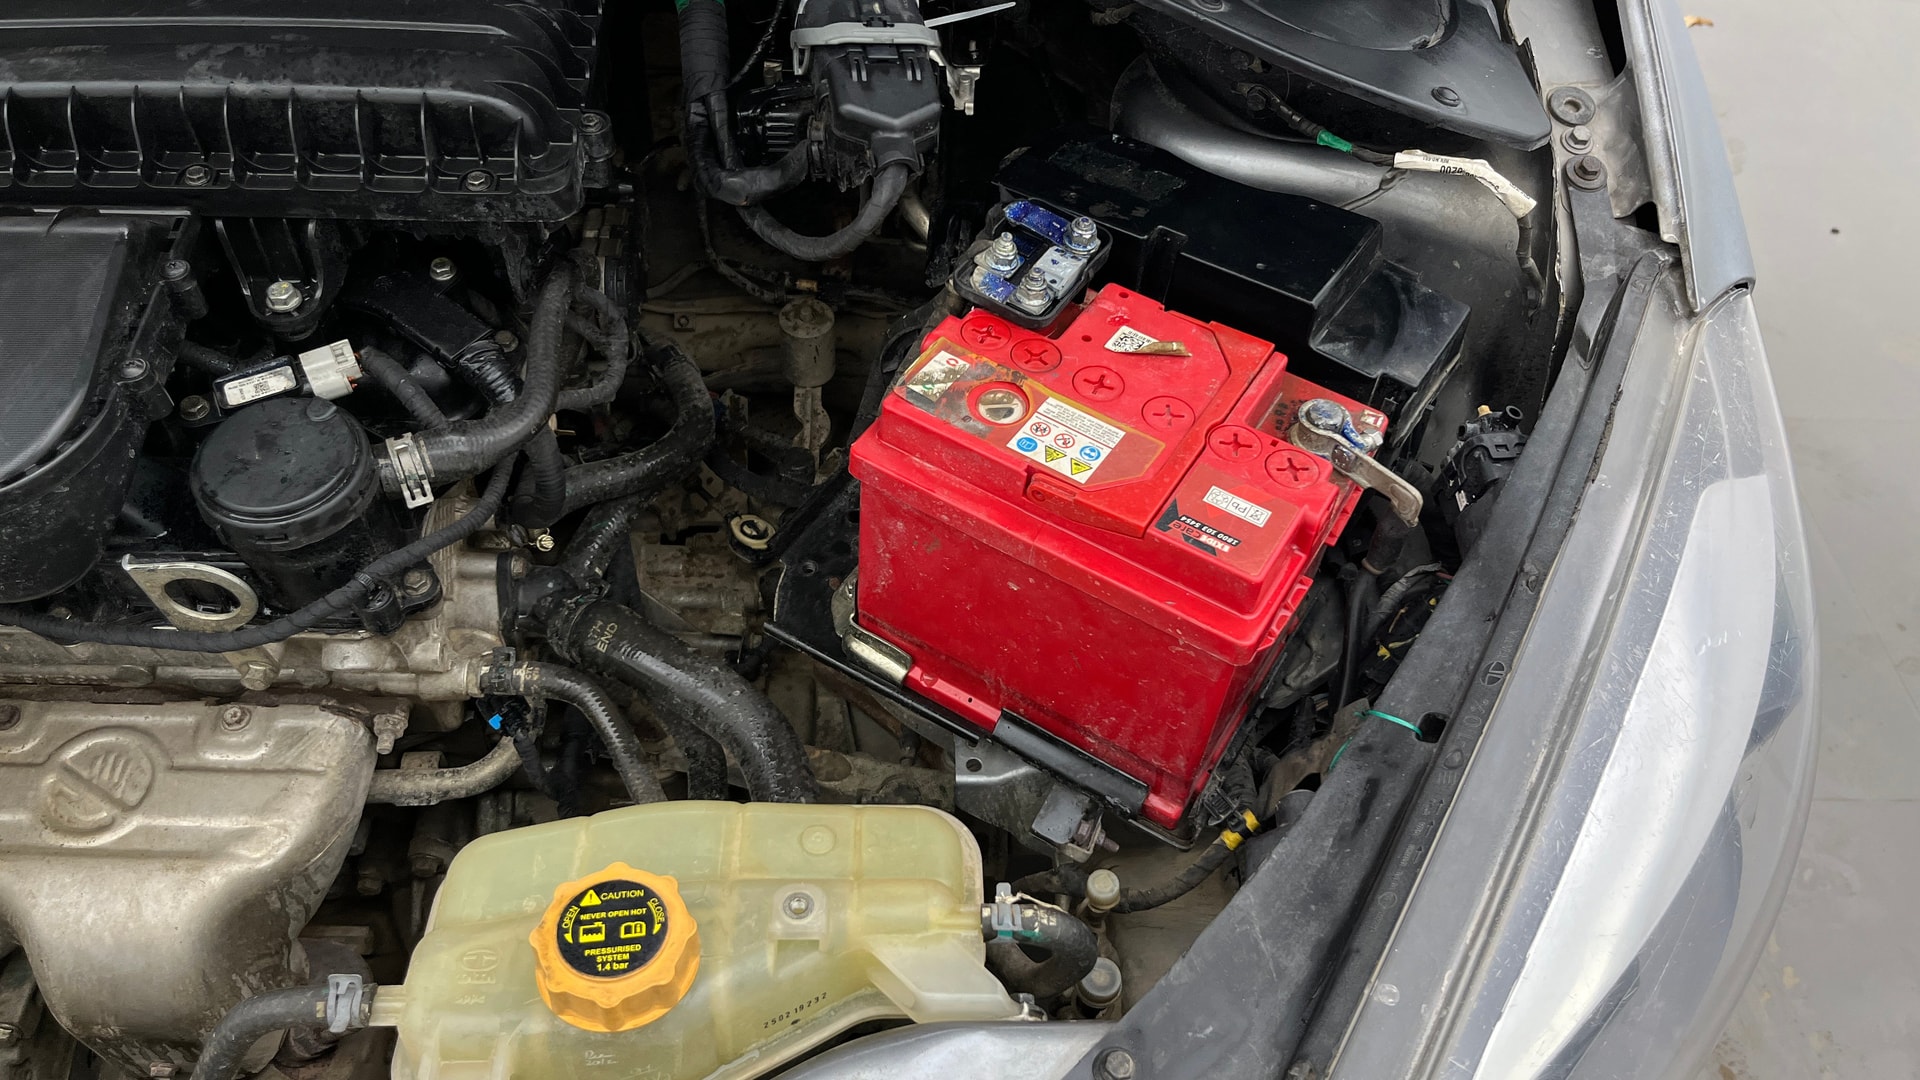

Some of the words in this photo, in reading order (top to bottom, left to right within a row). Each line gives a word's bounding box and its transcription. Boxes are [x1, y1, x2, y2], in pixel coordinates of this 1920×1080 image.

[1231, 501, 1248, 514] Pb
[1180, 515, 1201, 528] 5454
[1201, 525, 1218, 536] 103
[1217, 533, 1239, 546] 1800
[595, 622, 618, 653] END
[600, 889, 645, 900] CAUTION
[580, 911, 607, 921] NEVER
[607, 909, 630, 918] OPEN
[630, 907, 647, 916] HOT
[649, 897, 665, 922] CLOSE
[562, 905, 579, 929] OPEN
[584, 943, 642, 956] PRESSURISED
[596, 953, 630, 963] SYSTEM
[596, 963, 611, 972] 1.4
[612, 961, 629, 971] bar
